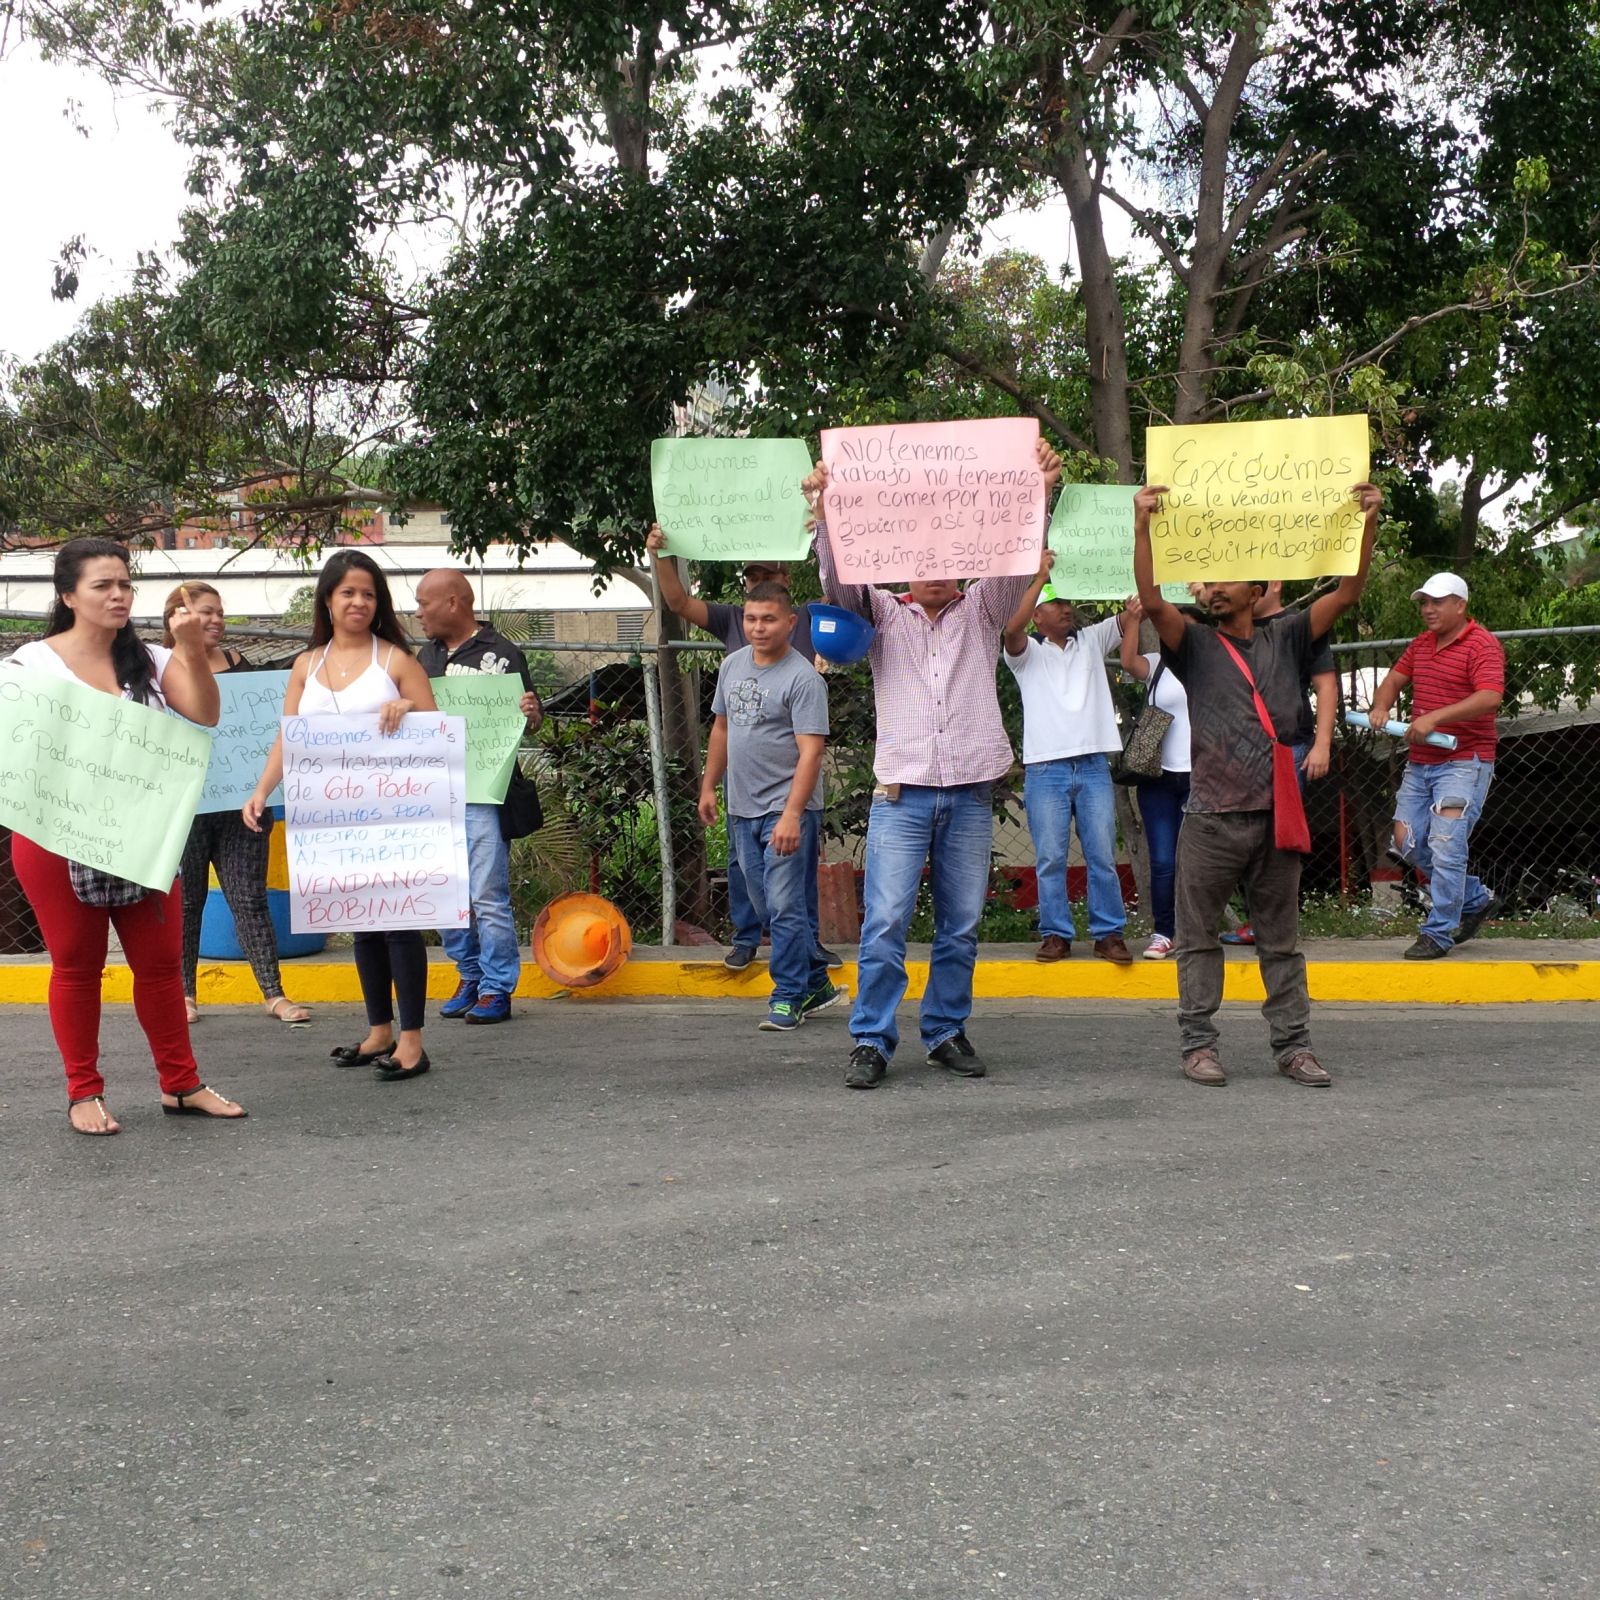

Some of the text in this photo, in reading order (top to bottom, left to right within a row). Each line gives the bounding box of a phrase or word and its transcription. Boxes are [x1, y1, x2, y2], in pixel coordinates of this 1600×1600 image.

[841, 429, 979, 463] NO tenemos
[830, 462, 1040, 488] trabajo no tenemos
[1172, 439, 1352, 491] Exiguimos
[829, 494, 865, 517] que
[877, 490, 936, 507] comer
[989, 490, 1012, 507] no
[1016, 489, 1036, 506] el
[1206, 486, 1225, 508] le
[1231, 489, 1293, 507] vendan
[838, 517, 917, 547] gobierno
[931, 511, 965, 531] asi
[1018, 506, 1037, 527] le
[1154, 515, 1179, 538] al
[1207, 512, 1266, 534] poder
[1268, 511, 1363, 537] queremos
[1165, 533, 1357, 570] seguir trabajando
[943, 557, 992, 575] poder
[0, 681, 91, 728] omos
[285, 717, 372, 749] Queremos
[333, 749, 446, 776] trabajadores
[288, 779, 313, 801] de
[324, 776, 364, 801] 6to
[368, 773, 436, 798] Poder
[290, 804, 435, 825] LUCHAMOS POR
[294, 825, 449, 847] NUESTRO DERECHO
[295, 850, 328, 866] AL
[329, 843, 436, 866] TRABAJO
[296, 866, 449, 898] VENDANOS
